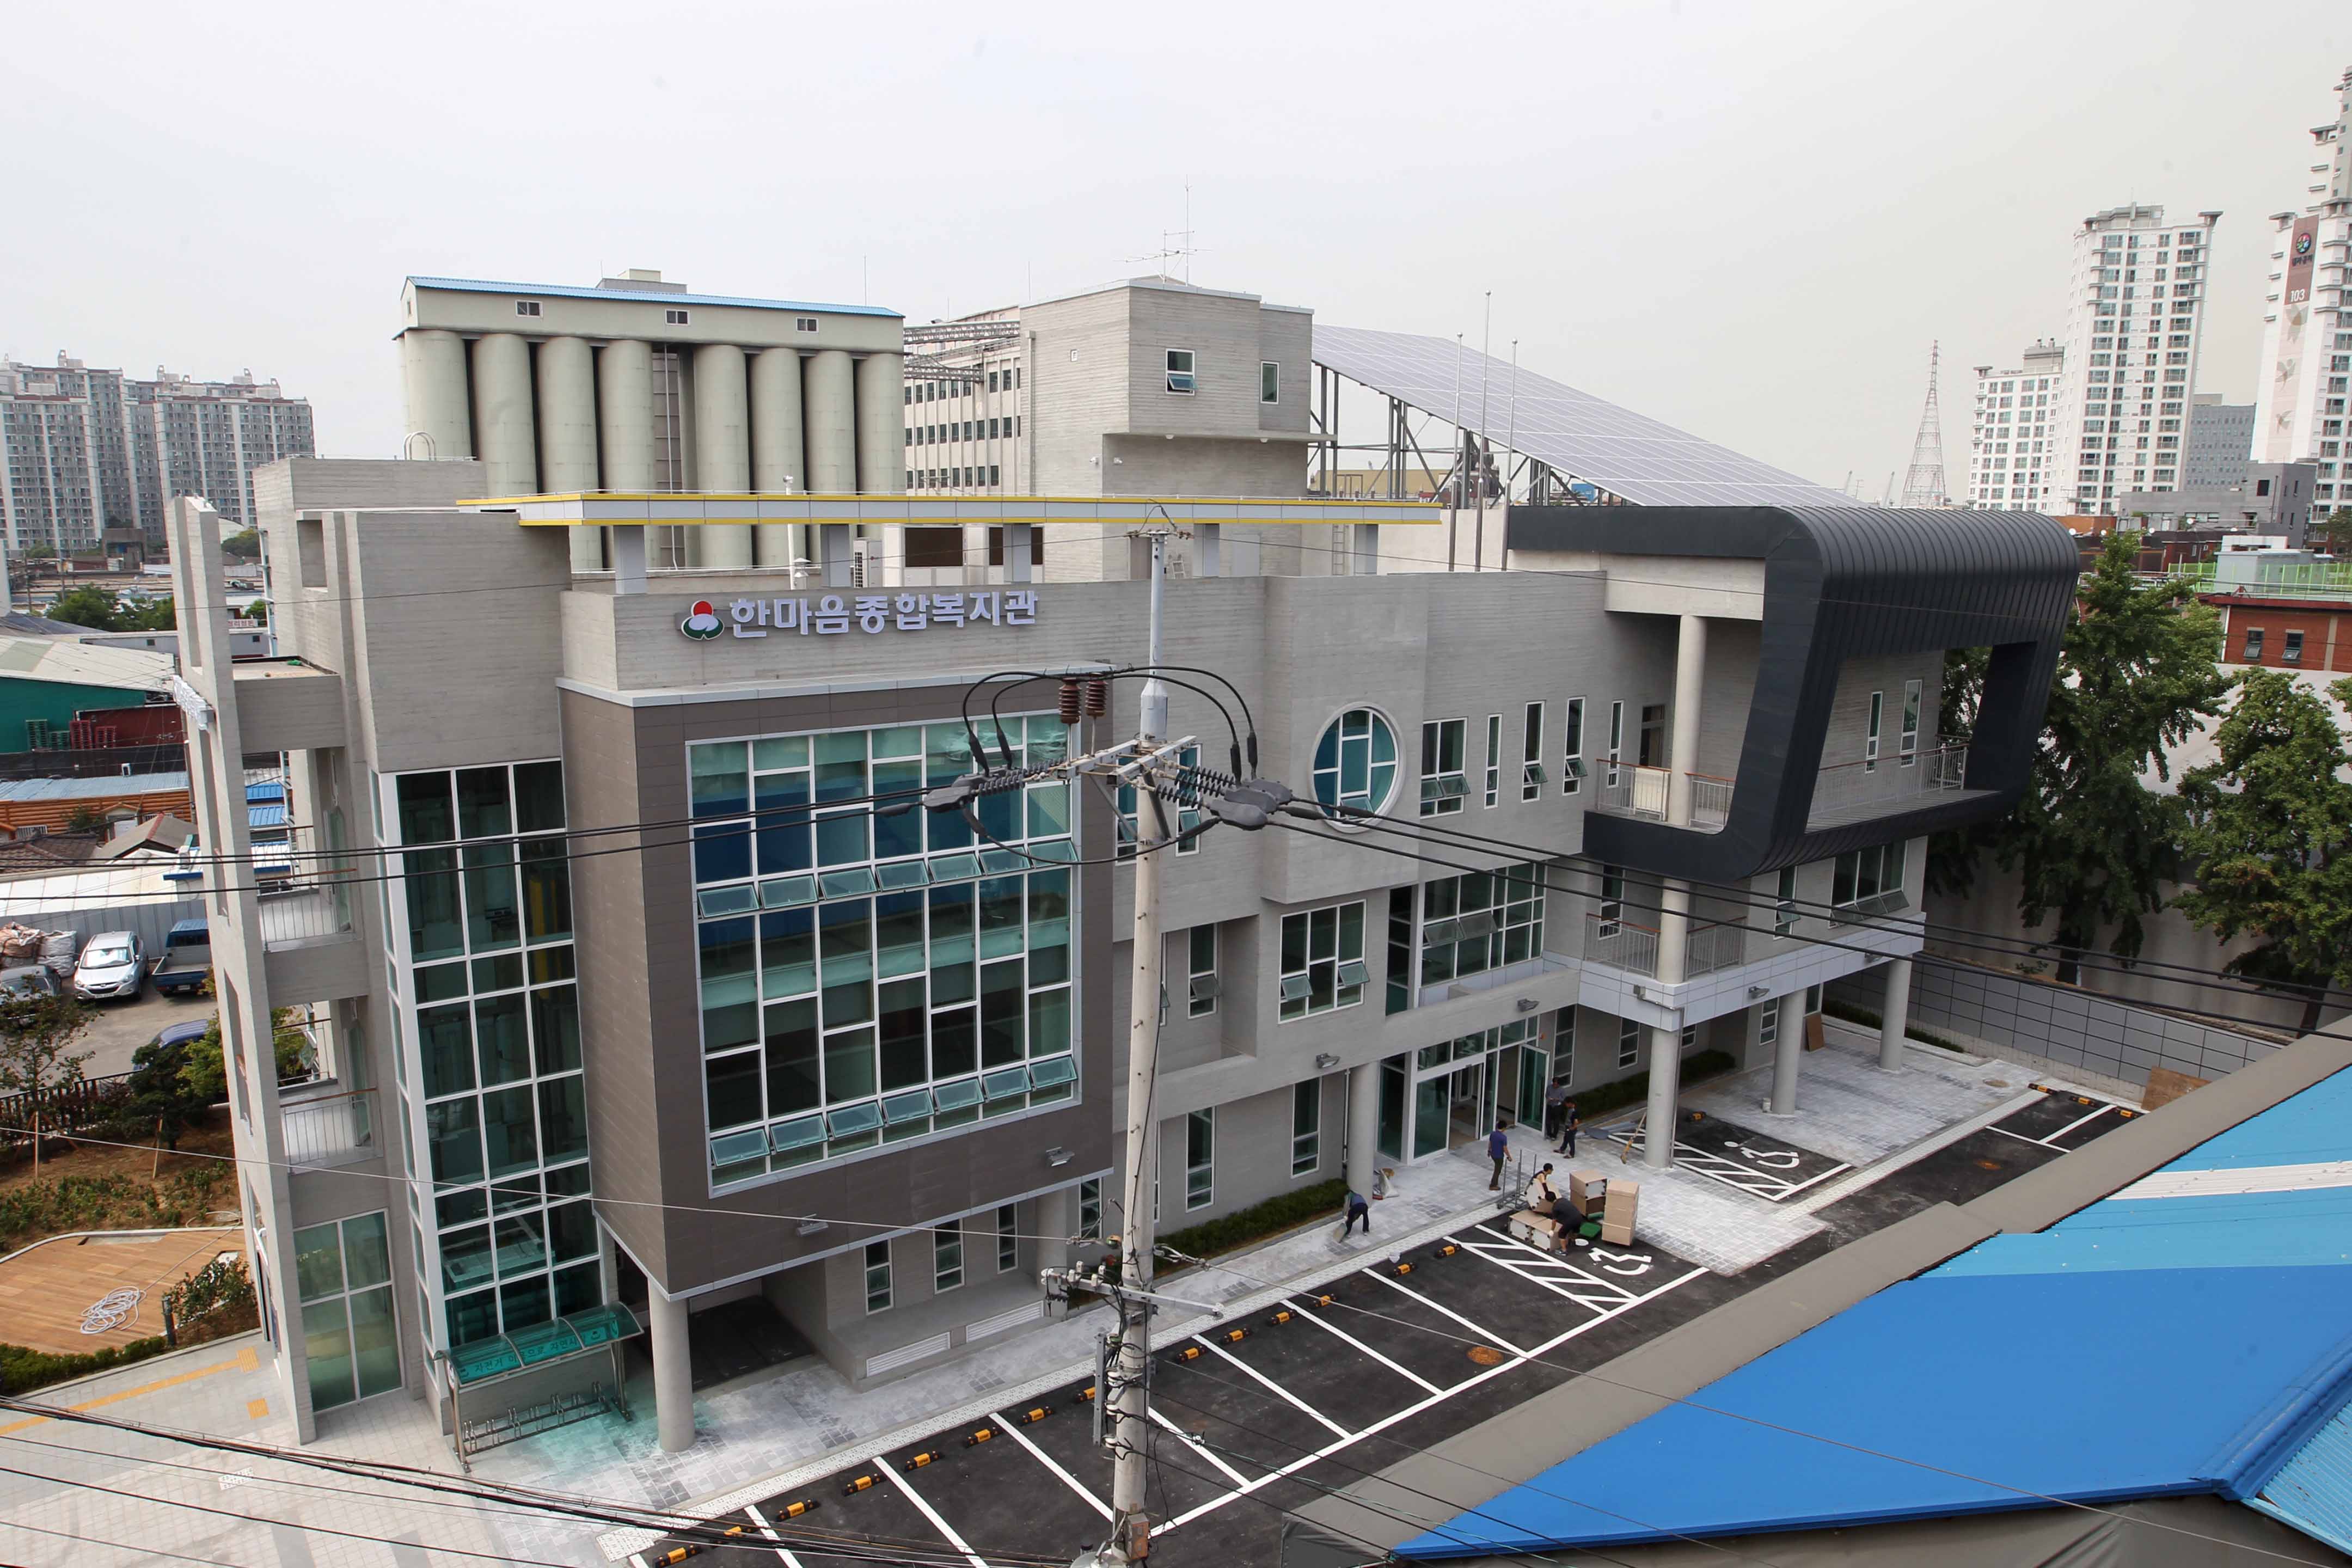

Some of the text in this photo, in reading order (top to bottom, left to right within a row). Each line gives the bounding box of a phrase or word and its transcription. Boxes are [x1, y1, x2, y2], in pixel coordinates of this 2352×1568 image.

[2290, 289, 2305, 302] 103
[729, 590, 1038, 638] 한마음종합복지관
[549, 1336, 585, 1350] 자연사
